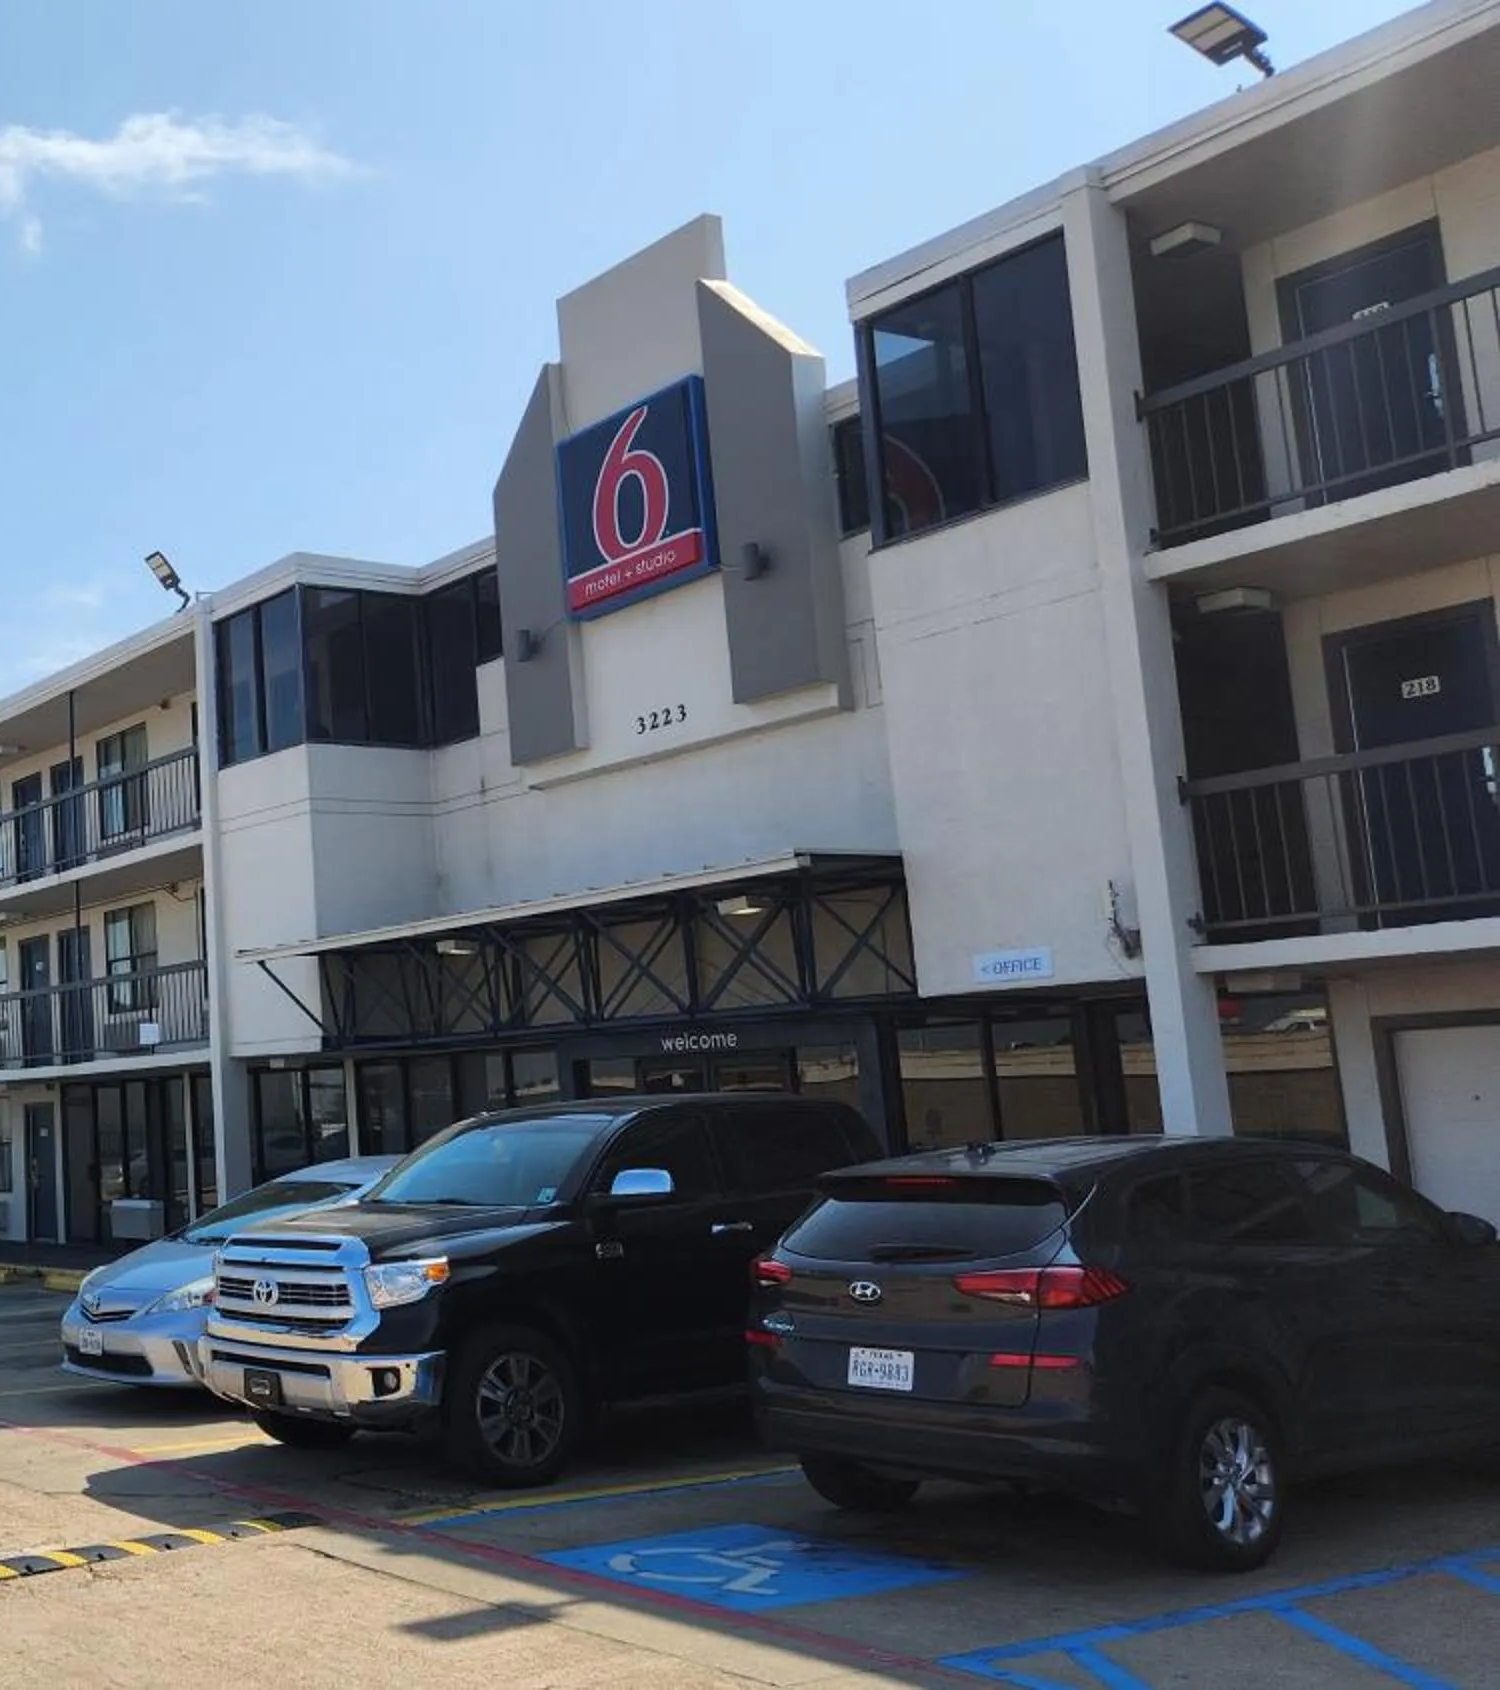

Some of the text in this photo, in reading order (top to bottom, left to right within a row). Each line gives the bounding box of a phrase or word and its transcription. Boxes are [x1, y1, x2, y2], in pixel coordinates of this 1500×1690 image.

[593, 405, 669, 564] 6
[585, 569, 622, 597] motel
[635, 549, 677, 576] studio
[1404, 677, 1436, 696] 218
[635, 704, 688, 735] 3223
[993, 957, 1042, 975] OFFICE
[660, 1031, 737, 1052] welcome
